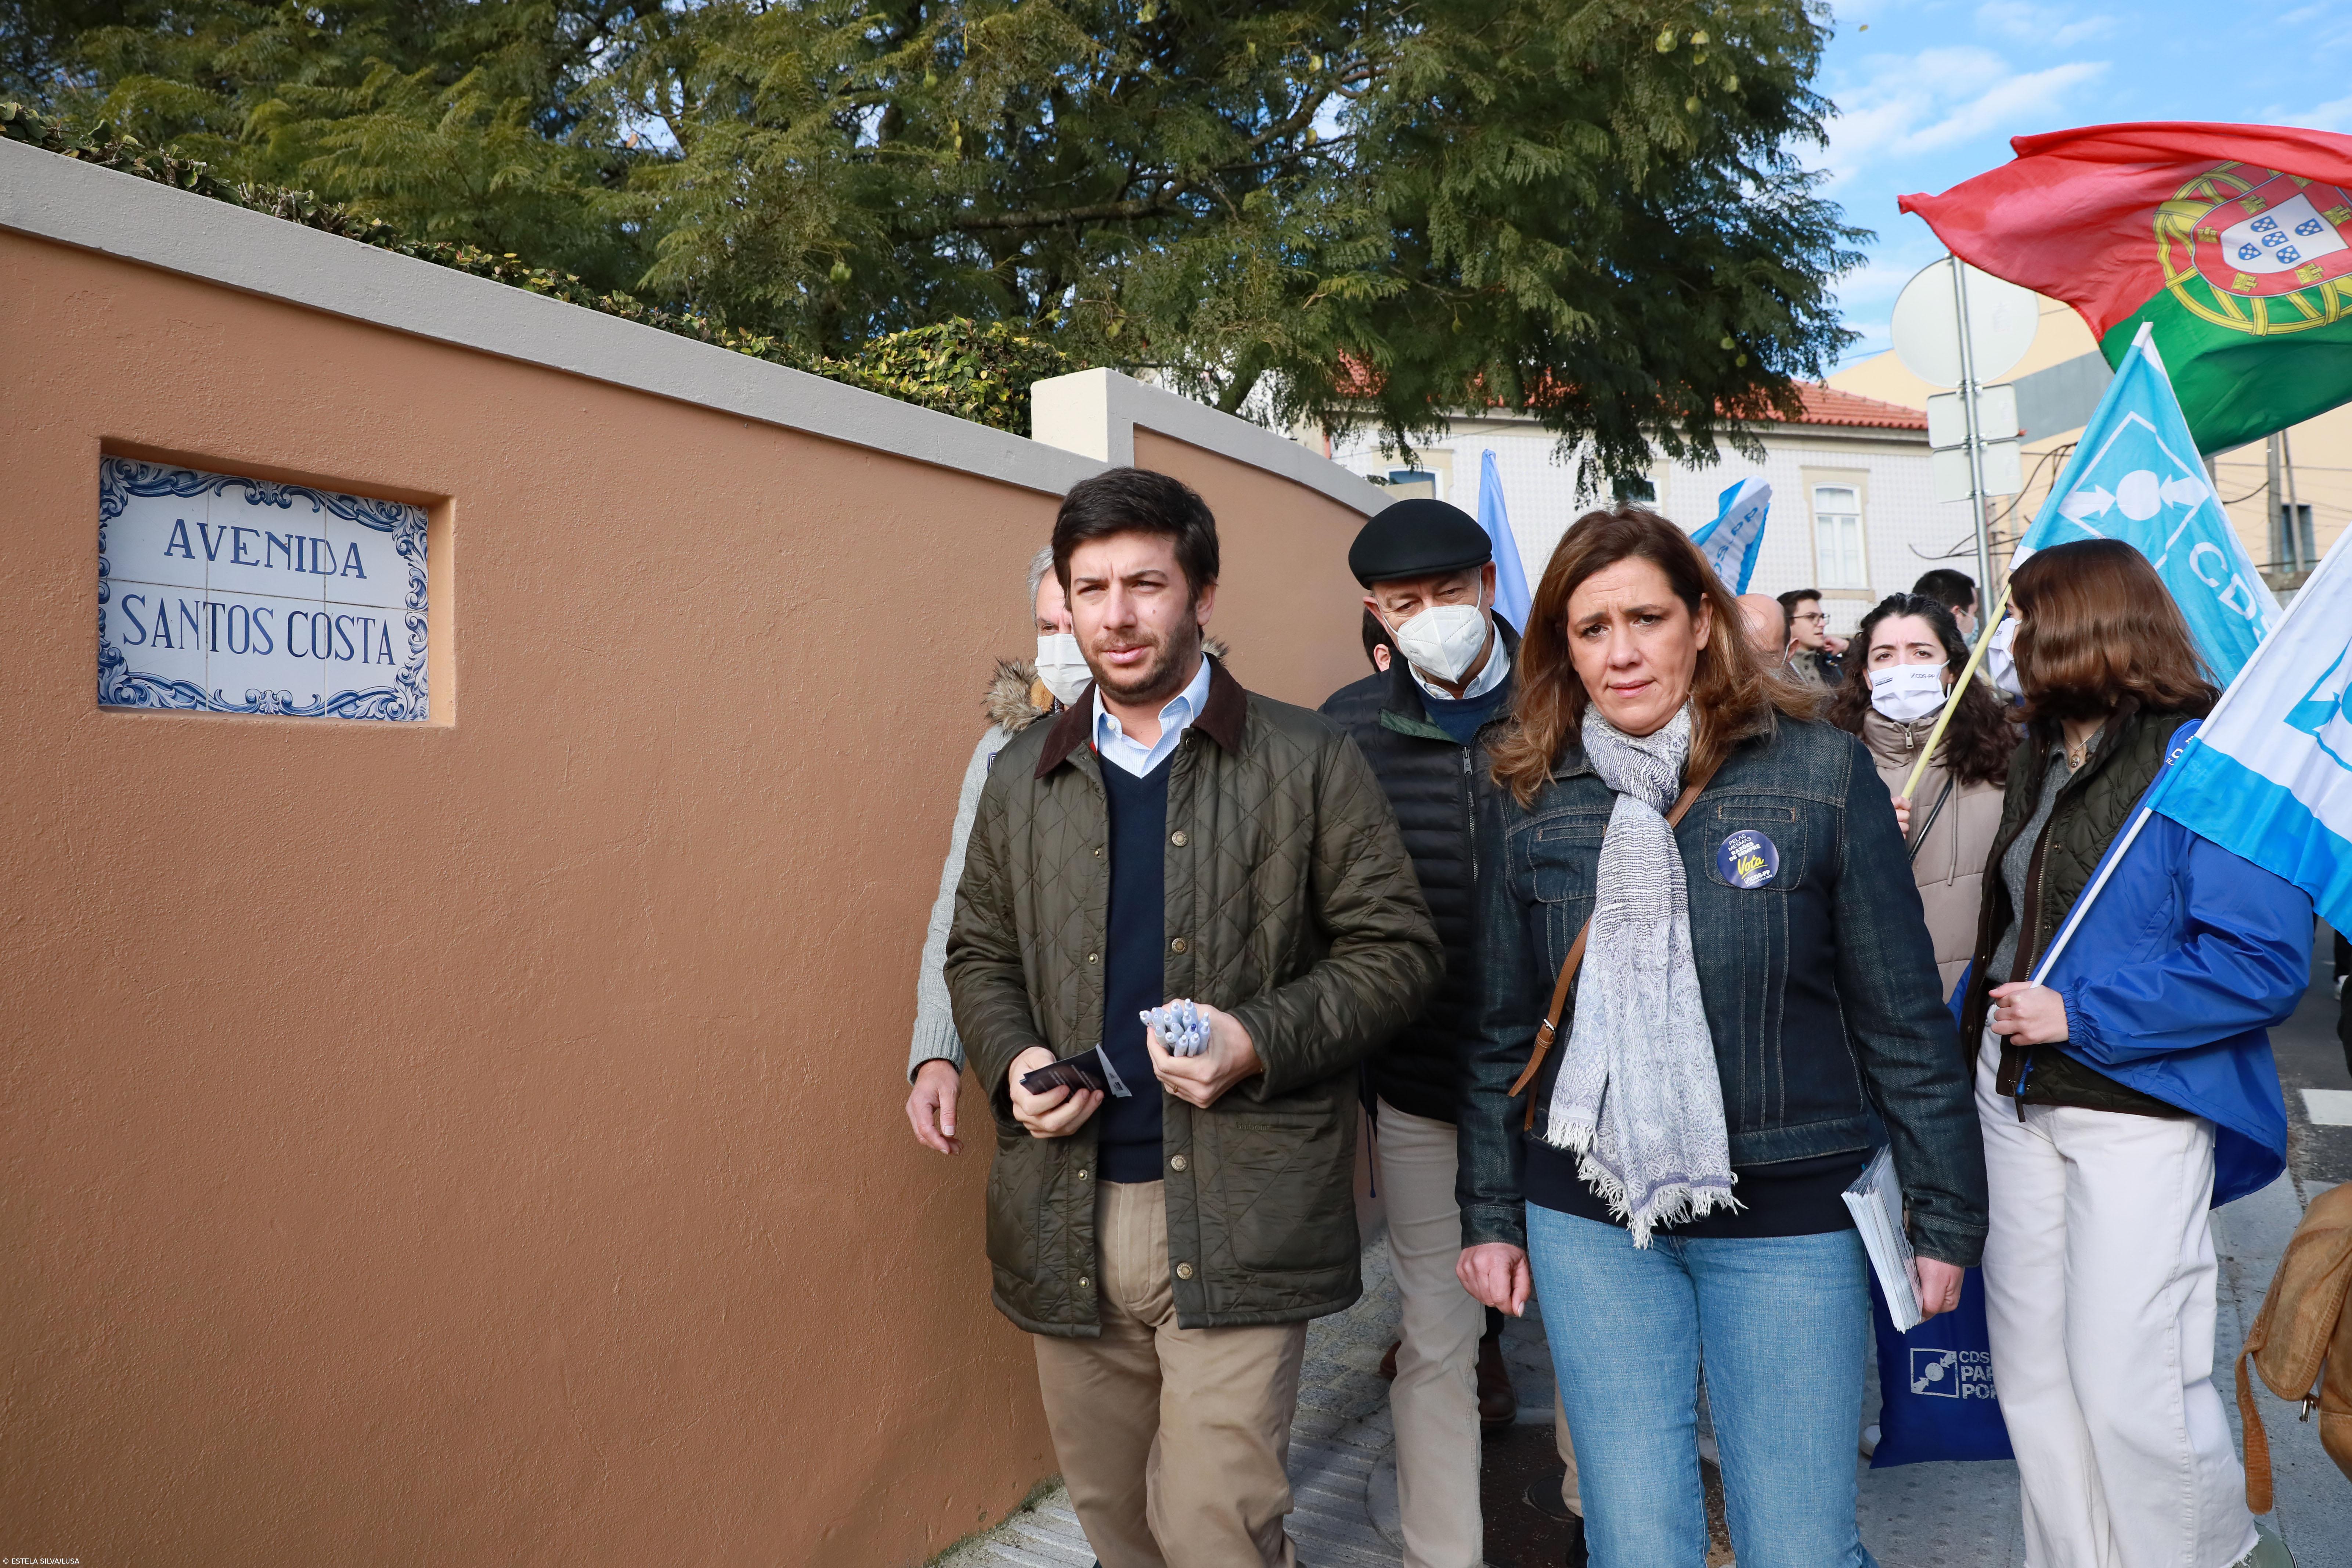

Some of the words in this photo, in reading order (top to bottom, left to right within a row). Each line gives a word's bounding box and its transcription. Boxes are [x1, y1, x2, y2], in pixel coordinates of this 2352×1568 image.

[163, 518, 367, 579] AVENIDA
[122, 594, 274, 655] SANTOS
[287, 610, 396, 666] COSTA
[1728, 834, 1746, 846] PELAS
[1728, 836, 1752, 851] MESMAS
[1731, 841, 1754, 856] RAZÕES
[1737, 843, 1761, 857] SEMPRE
[1738, 855, 1764, 875] Vota
[1746, 877, 1766, 887] LEGISLATIVAS
[1750, 869, 1771, 881] CDS-PP
[1235, 1121, 1270, 1131] Barbour
[1959, 1351, 1990, 1363] CDS
